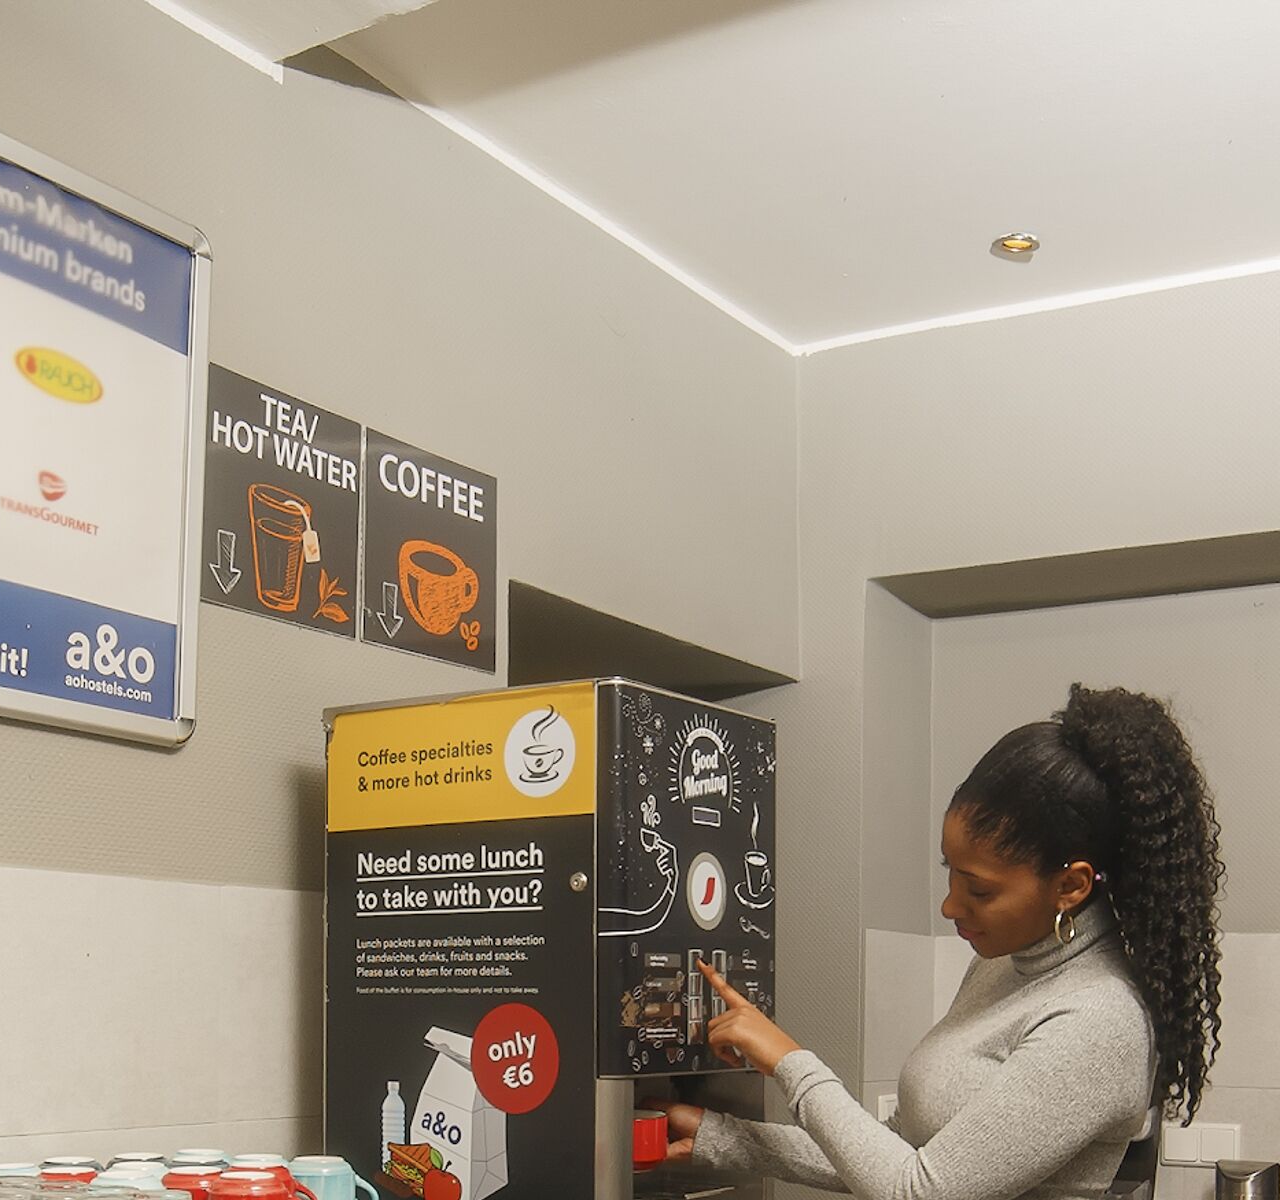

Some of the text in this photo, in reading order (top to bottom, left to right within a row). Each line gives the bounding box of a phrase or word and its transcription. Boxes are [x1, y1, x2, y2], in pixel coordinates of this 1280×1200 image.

[64, 250, 146, 313] brands
[37, 358, 95, 399] RAUCH
[259, 393, 319, 443] TEA/
[211, 410, 358, 492] HOT WATER
[378, 453, 485, 523] COFFEE
[64, 622, 156, 685] a&o
[64, 673, 153, 703] aohostels.com
[357, 739, 494, 767] Coffee specialties
[691, 748, 720, 776] Good
[357, 765, 493, 793] & more hot drinks
[683, 772, 728, 800] Morning
[357, 841, 544, 876] Need some lunch
[356, 878, 544, 911] to take with you?
[356, 933, 546, 951] Lunch packets are available with a selection
[356, 949, 529, 964] of sandwiches, drinks, fruits and snacks.
[356, 964, 513, 978] Please ask our team for more details.
[487, 1031, 536, 1062] only
[502, 1061, 535, 1089] €6
[421, 1111, 462, 1146] a&o
